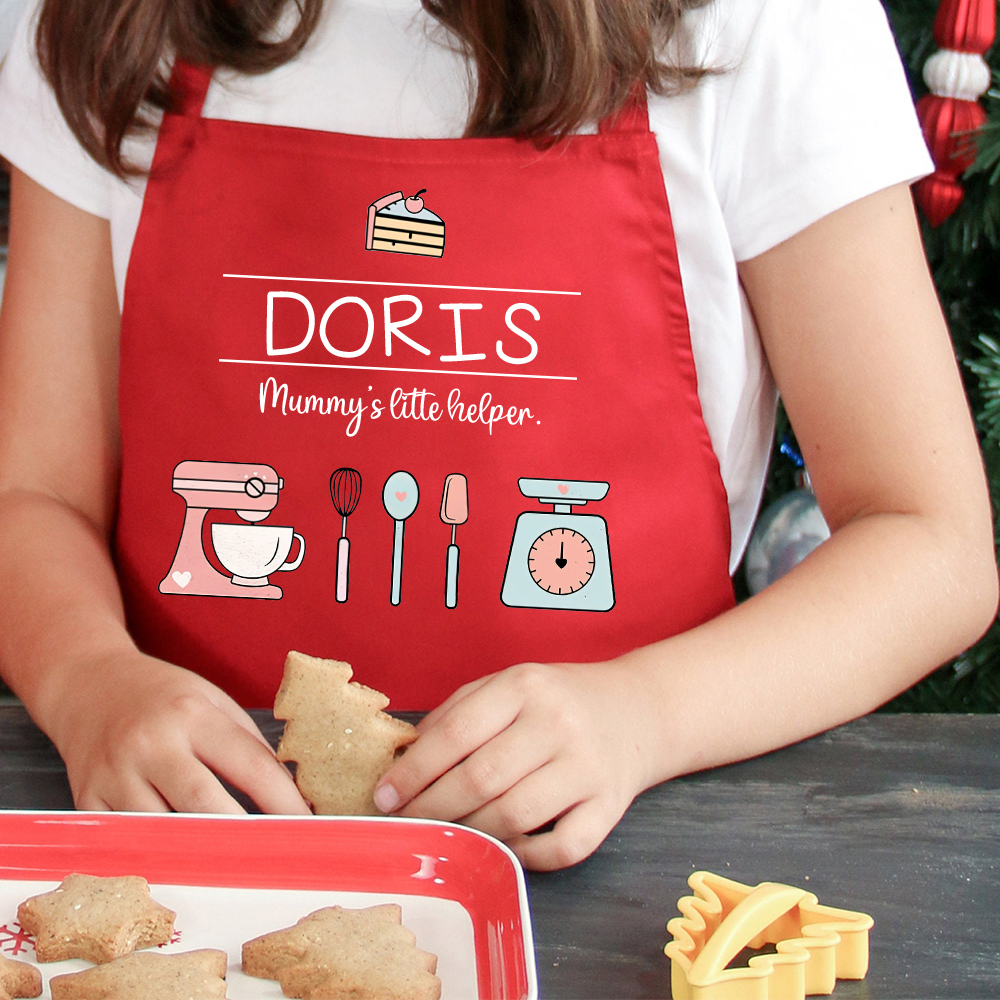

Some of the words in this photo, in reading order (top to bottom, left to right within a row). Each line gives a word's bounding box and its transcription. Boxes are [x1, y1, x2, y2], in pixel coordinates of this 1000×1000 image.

[265, 290, 541, 365] DORIS
[258, 376, 386, 438] Mummy's
[447, 388, 542, 436] helper.
